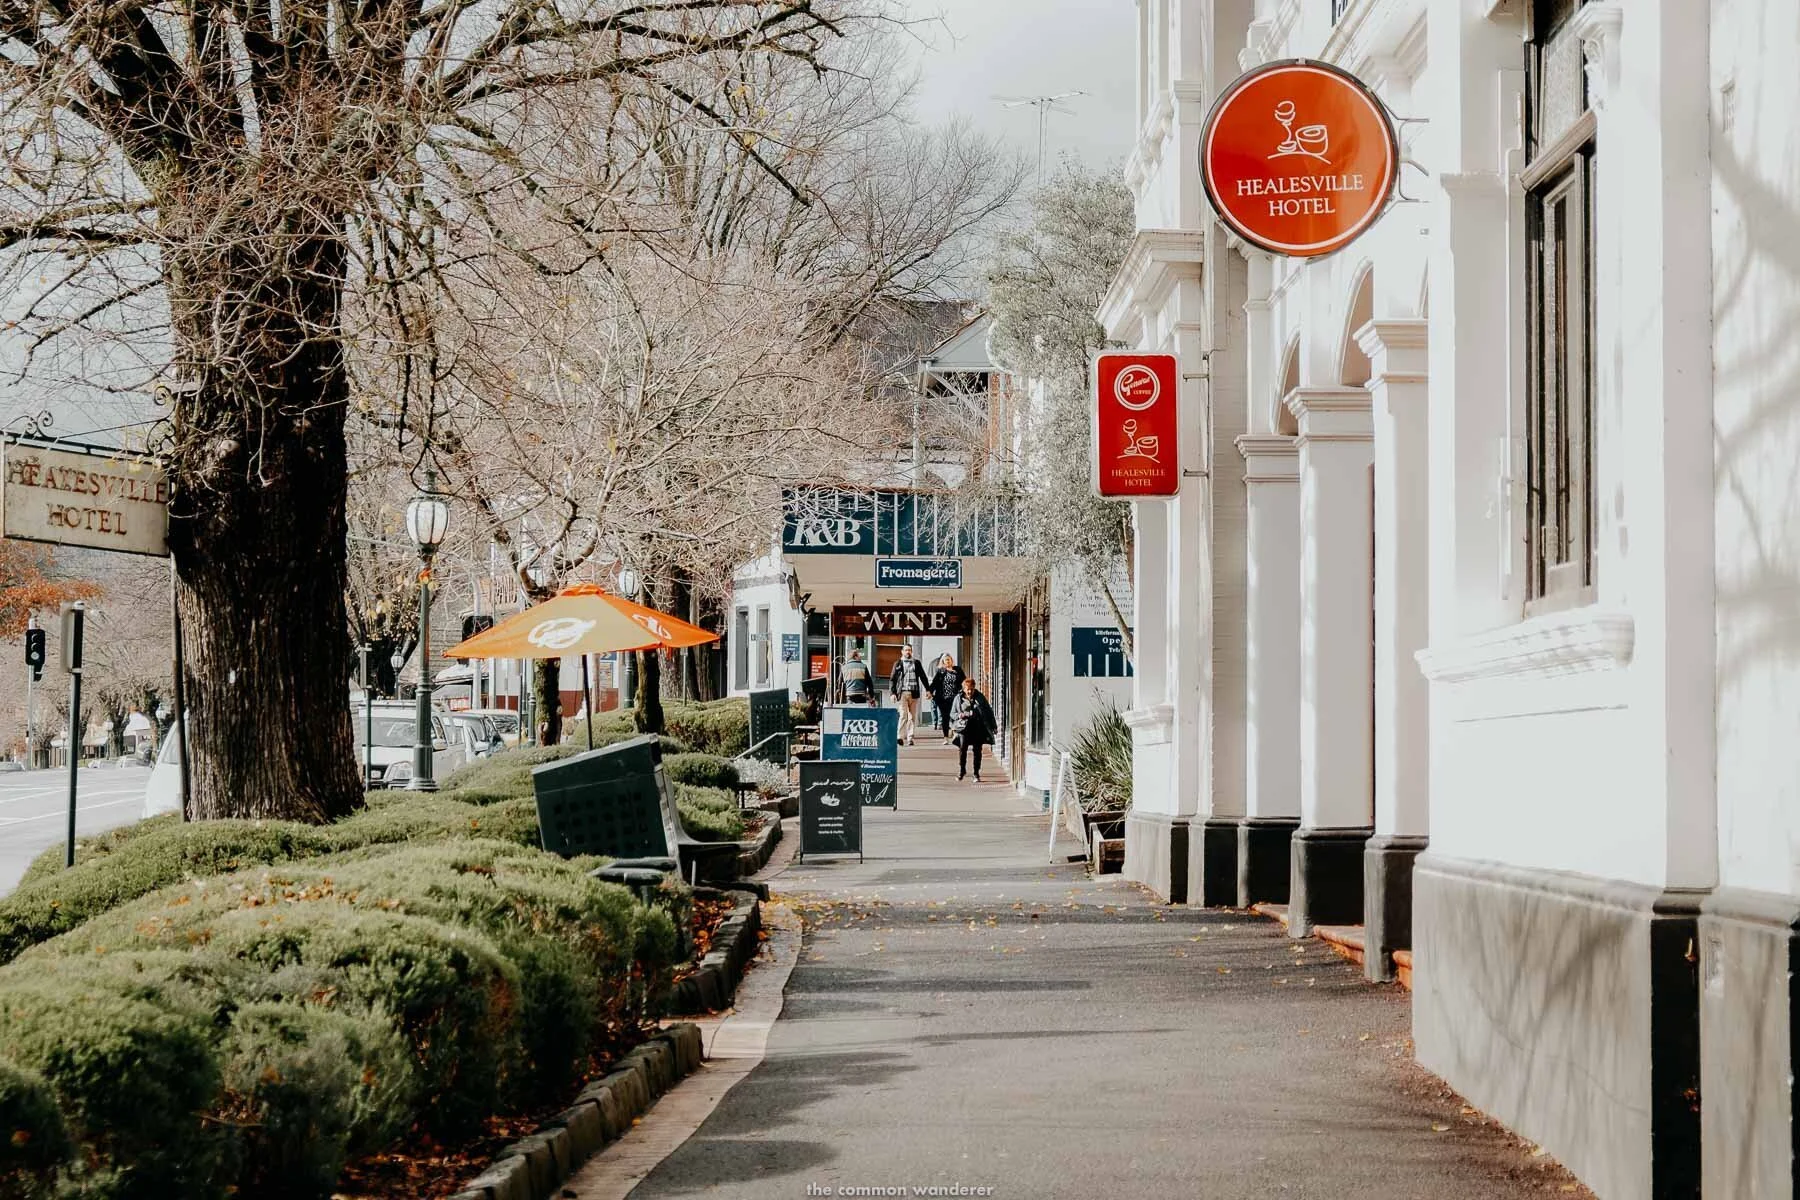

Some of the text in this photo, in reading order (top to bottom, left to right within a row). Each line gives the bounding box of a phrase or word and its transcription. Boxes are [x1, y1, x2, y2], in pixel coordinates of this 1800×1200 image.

[1237, 174, 1364, 196] HEALESVILLE
[1269, 198, 1335, 216] HOTEL
[7, 458, 168, 504] HEALESVILLE
[1111, 469, 1165, 477] HEALESVILLE
[1125, 478, 1152, 487] HOTEL
[47, 503, 127, 535] HOTEL
[785, 518, 861, 547] K&B
[881, 566, 957, 580] Fromagerie
[858, 611, 948, 632] WINE
[843, 719, 878, 734] K&B
[861, 773, 893, 783] RPENING
